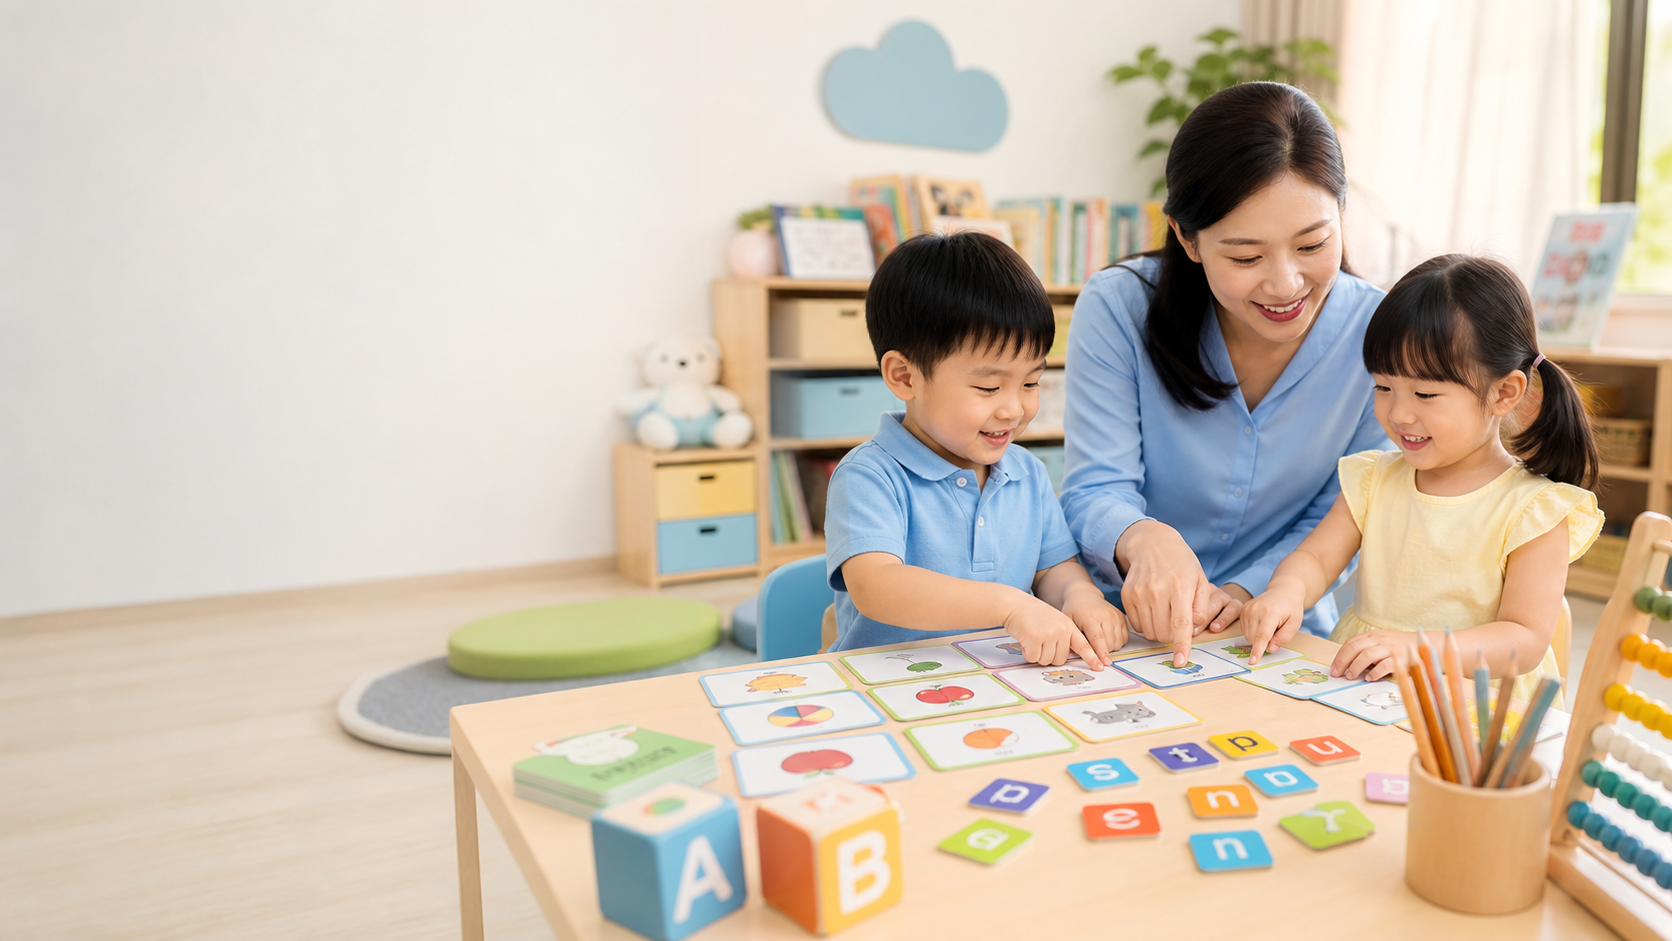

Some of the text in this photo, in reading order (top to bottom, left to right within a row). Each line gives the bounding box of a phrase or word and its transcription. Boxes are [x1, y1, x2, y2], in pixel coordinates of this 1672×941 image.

[1168, 747, 1198, 763] t
[1086, 763, 1120, 781] s
[1205, 790, 1240, 809] n
[1102, 808, 1141, 830] e
[1212, 837, 1249, 860] n
[672, 834, 734, 925] A
[836, 829, 892, 916] B
